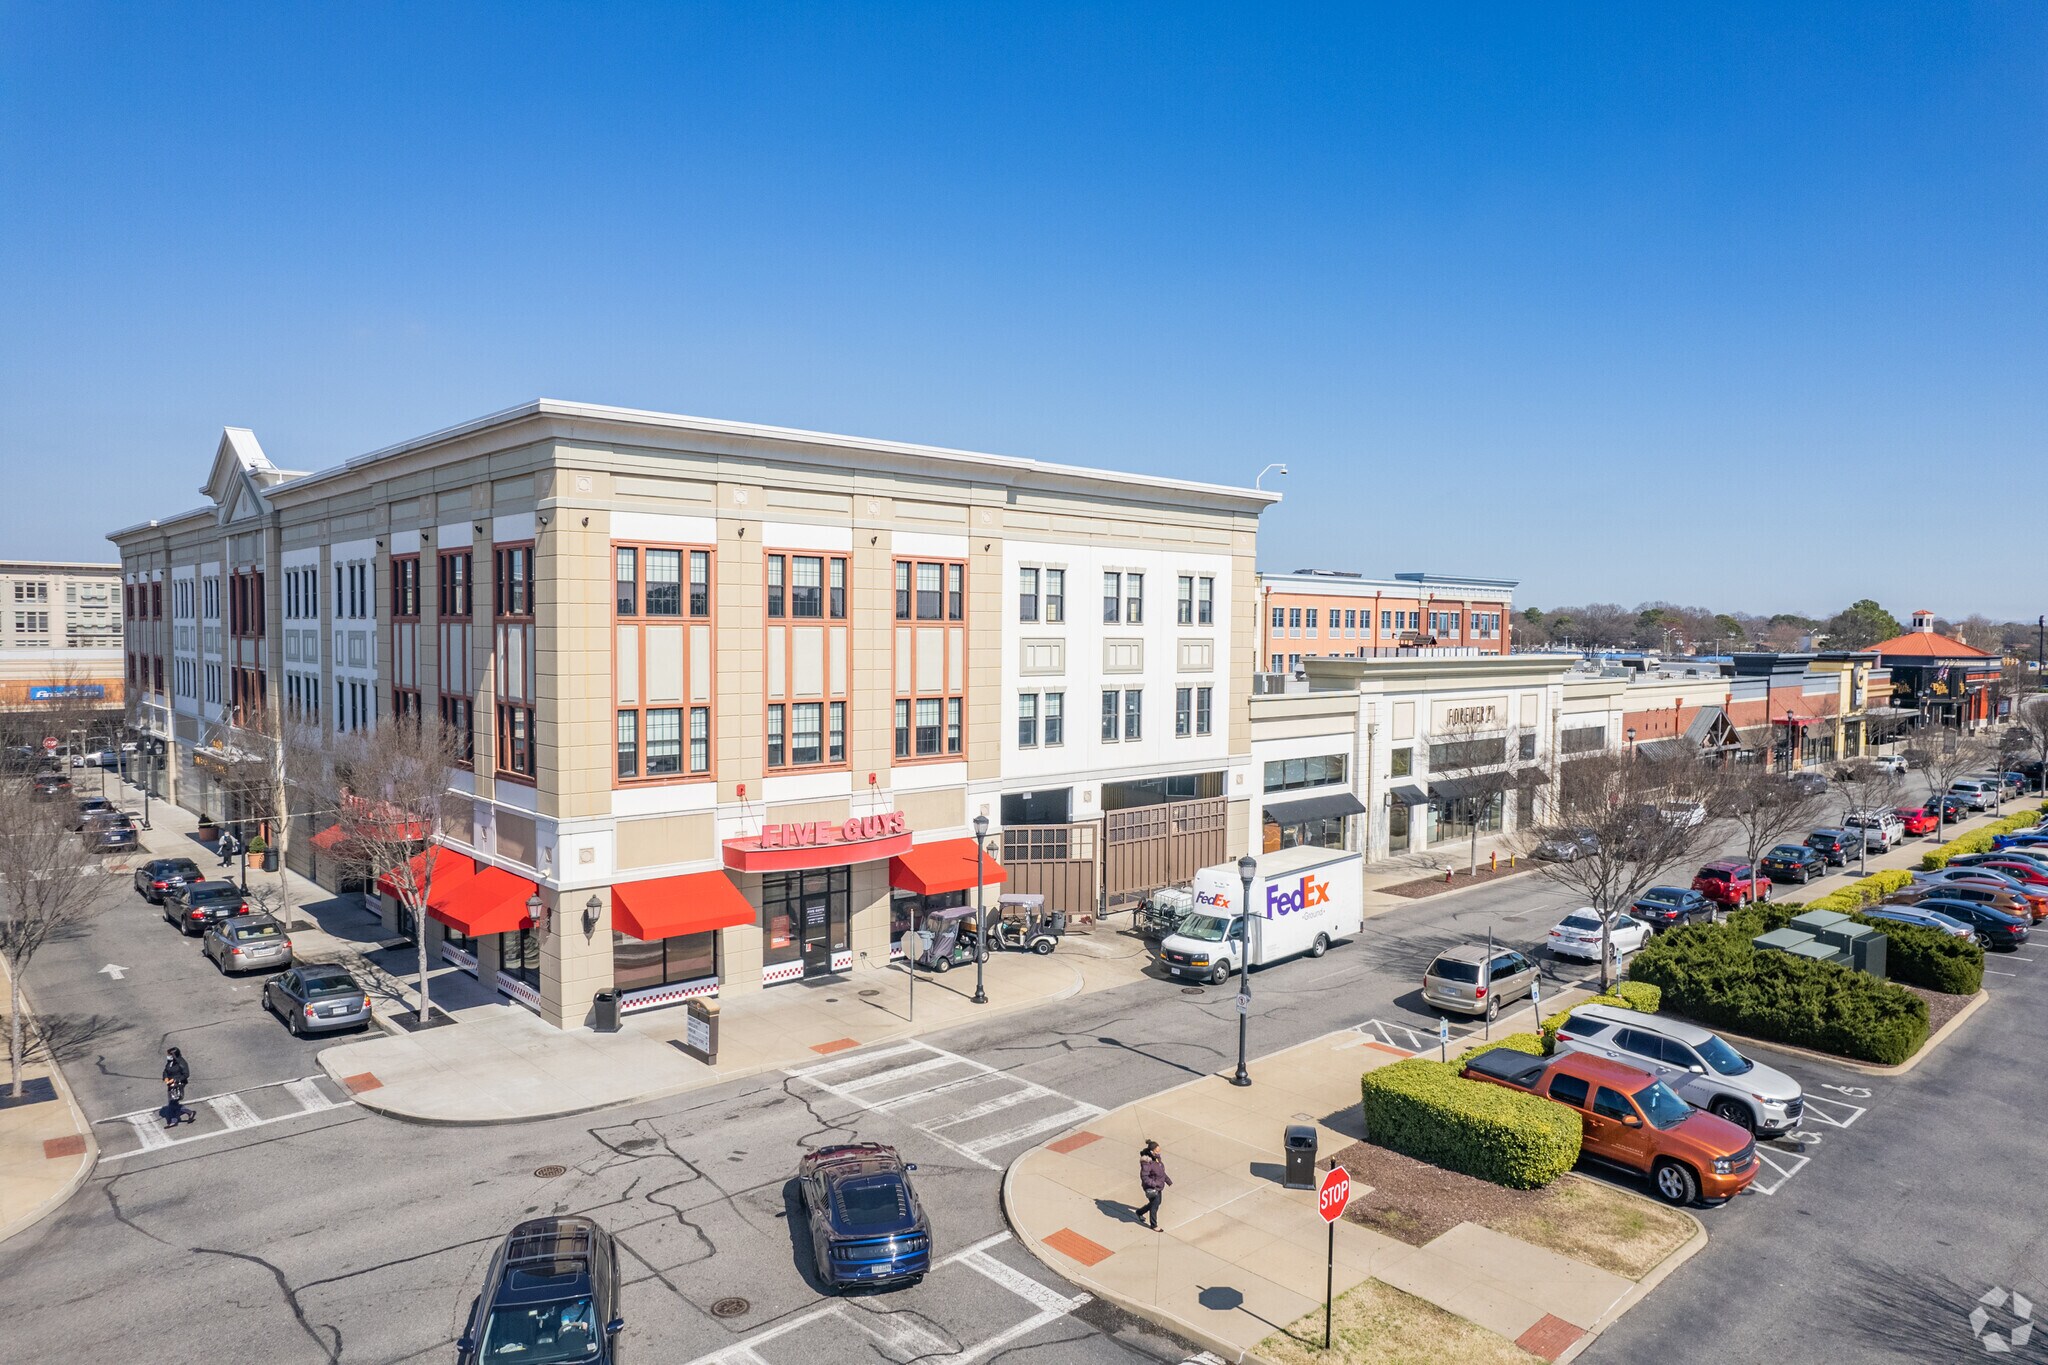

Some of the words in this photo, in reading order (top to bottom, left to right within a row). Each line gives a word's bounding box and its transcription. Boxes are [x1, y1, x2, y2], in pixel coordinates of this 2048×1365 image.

[1447, 706, 1484, 726] FOREVER
[1485, 705, 1495, 723] 21
[762, 821, 832, 848] FIVE
[842, 810, 905, 841] GUYS
[1196, 891, 1231, 909] FedEx
[1267, 874, 1330, 919] FedEx
[1303, 909, 1323, 921] Ground
[1321, 1180, 1348, 1209] STOP
